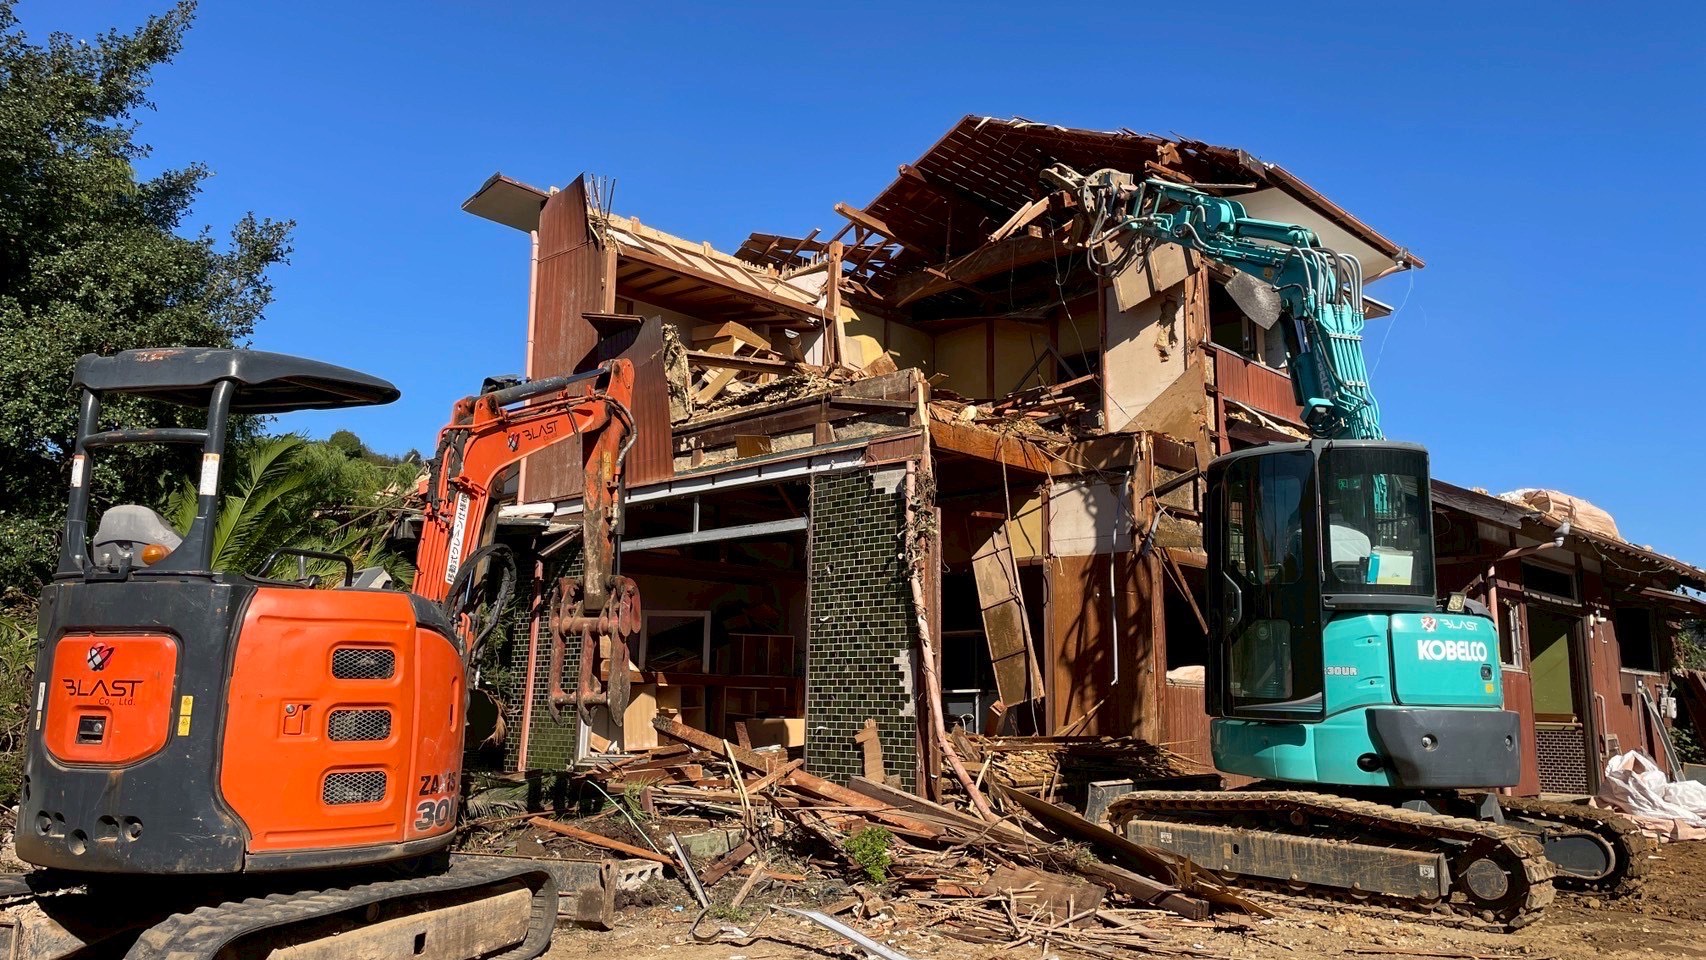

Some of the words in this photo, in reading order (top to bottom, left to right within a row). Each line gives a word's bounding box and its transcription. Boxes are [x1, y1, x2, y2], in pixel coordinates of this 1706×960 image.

[522, 420, 558, 441] BLAST
[1439, 618, 1478, 631] BLAST
[1417, 639, 1488, 662] KOBELCO
[62, 678, 144, 697] BLAST
[118, 697, 136, 706] Ltd.
